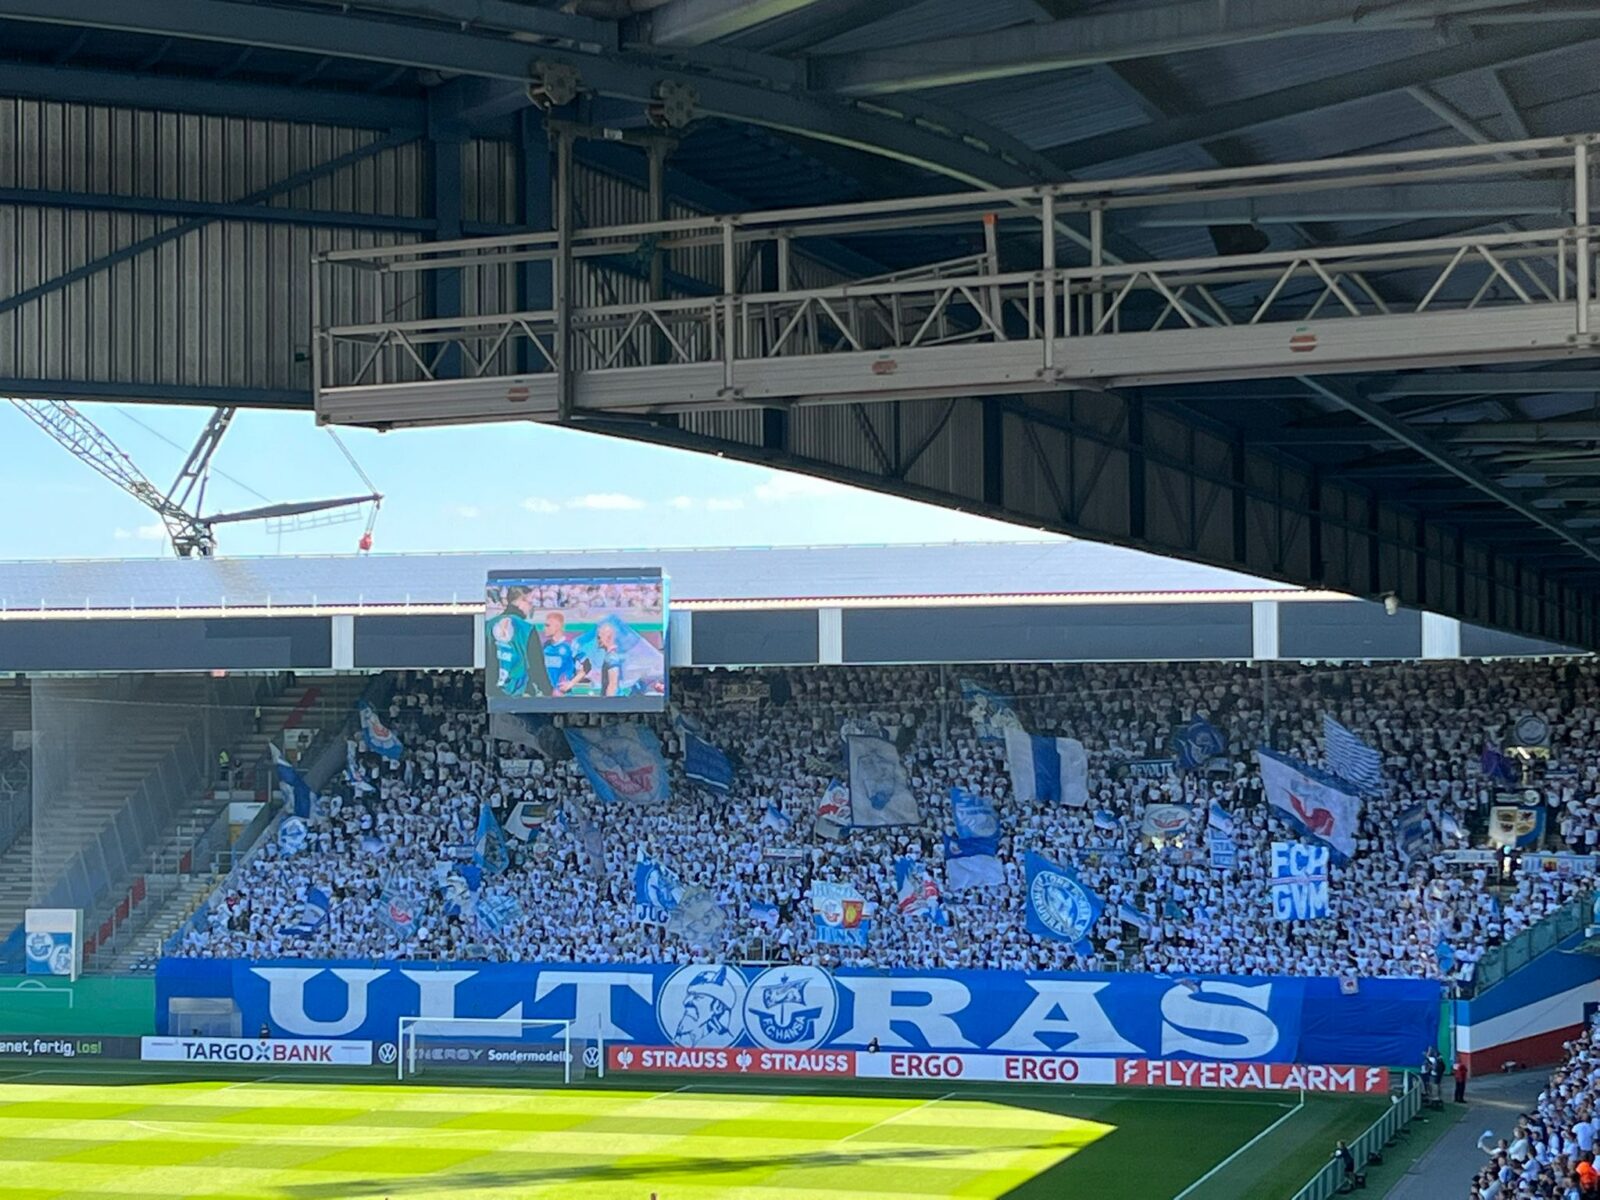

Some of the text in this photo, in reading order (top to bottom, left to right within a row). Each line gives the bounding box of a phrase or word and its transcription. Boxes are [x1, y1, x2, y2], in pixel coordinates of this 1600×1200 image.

[76, 1041, 102, 1054] los!
[641, 1050, 728, 1069] STRAUSS
[760, 1053, 848, 1072] STRAUSS
[891, 1055, 963, 1077] ERGO
[1005, 1057, 1079, 1081] ERGO
[1147, 1061, 1356, 1092] FLYERALARM
